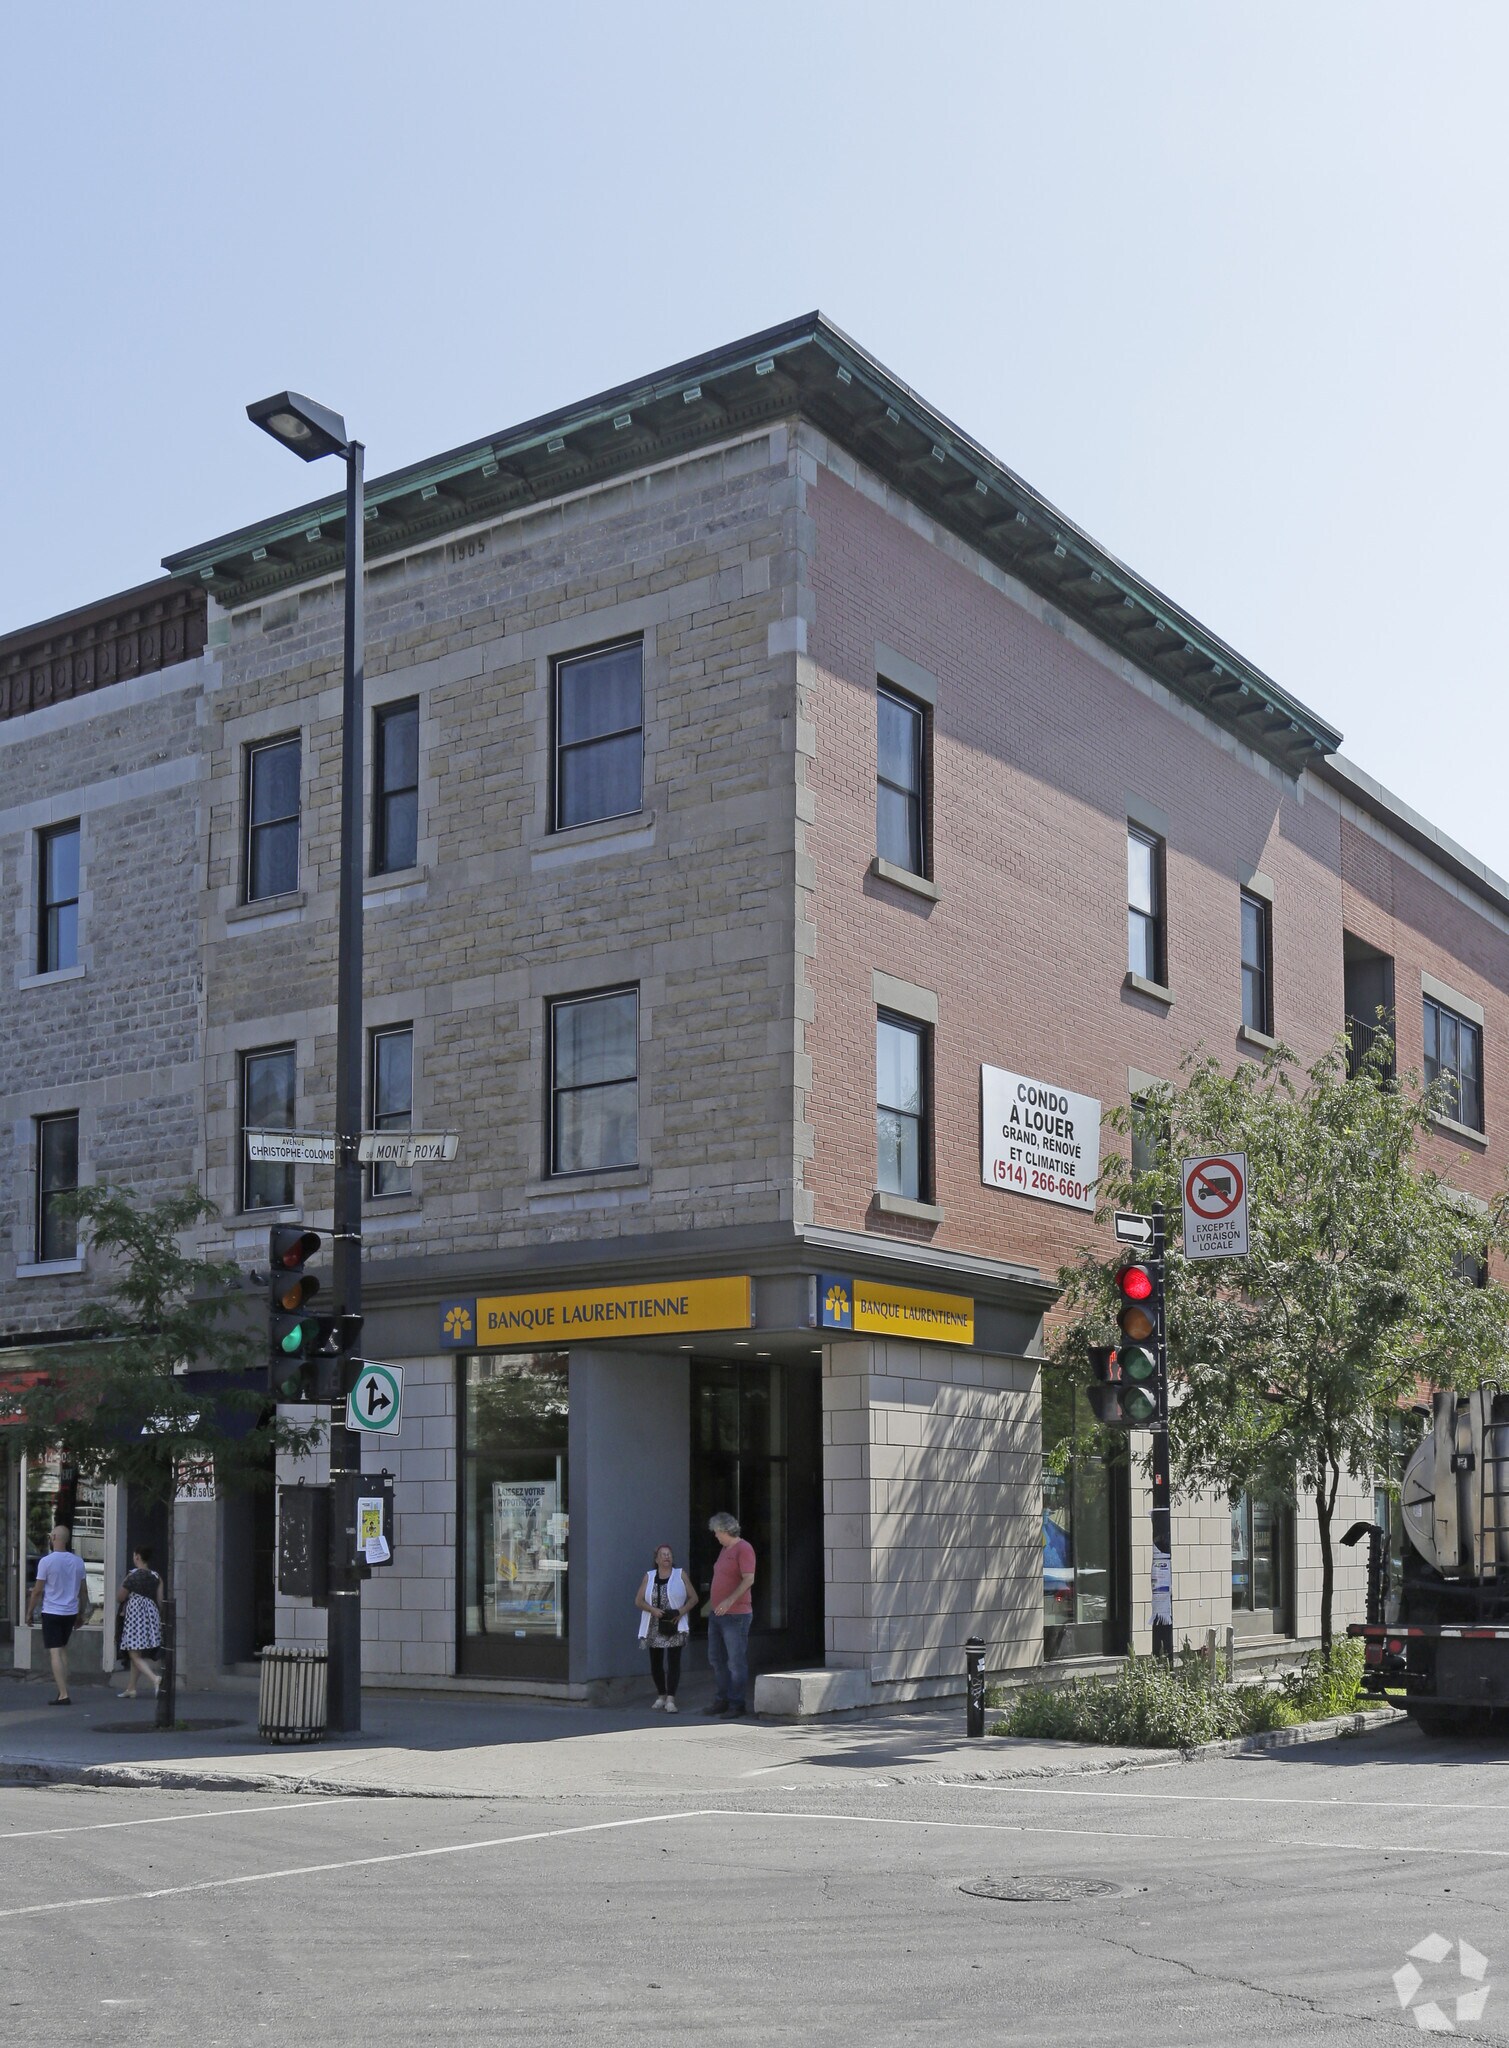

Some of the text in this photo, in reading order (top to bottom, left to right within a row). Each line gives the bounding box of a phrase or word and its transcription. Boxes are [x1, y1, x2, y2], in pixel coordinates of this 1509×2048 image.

[452, 538, 485, 564] 1905
[1017, 1083, 1069, 1115] CONDO
[1010, 1100, 1074, 1140] À LOUER
[251, 1146, 335, 1160] CHRISTOPHE-COLOMB
[282, 1138, 305, 1146] AVENUE
[1002, 1125, 1081, 1159] GRAND, RÉNOVÉ
[1010, 1147, 1076, 1176] ET CLIMATISÉ
[993, 1159, 1089, 1202] (514) 266-6601
[1192, 1230, 1241, 1243] LIVRAISON
[1196, 1220, 1236, 1233] EXCEPTÉ
[1200, 1240, 1234, 1251] LOCALE
[488, 1296, 689, 1330] BANQUE LAURENTIENNE
[860, 1299, 968, 1327] BANQUE LAURENTIENNE
[524, 1487, 545, 1496] VOTRE
